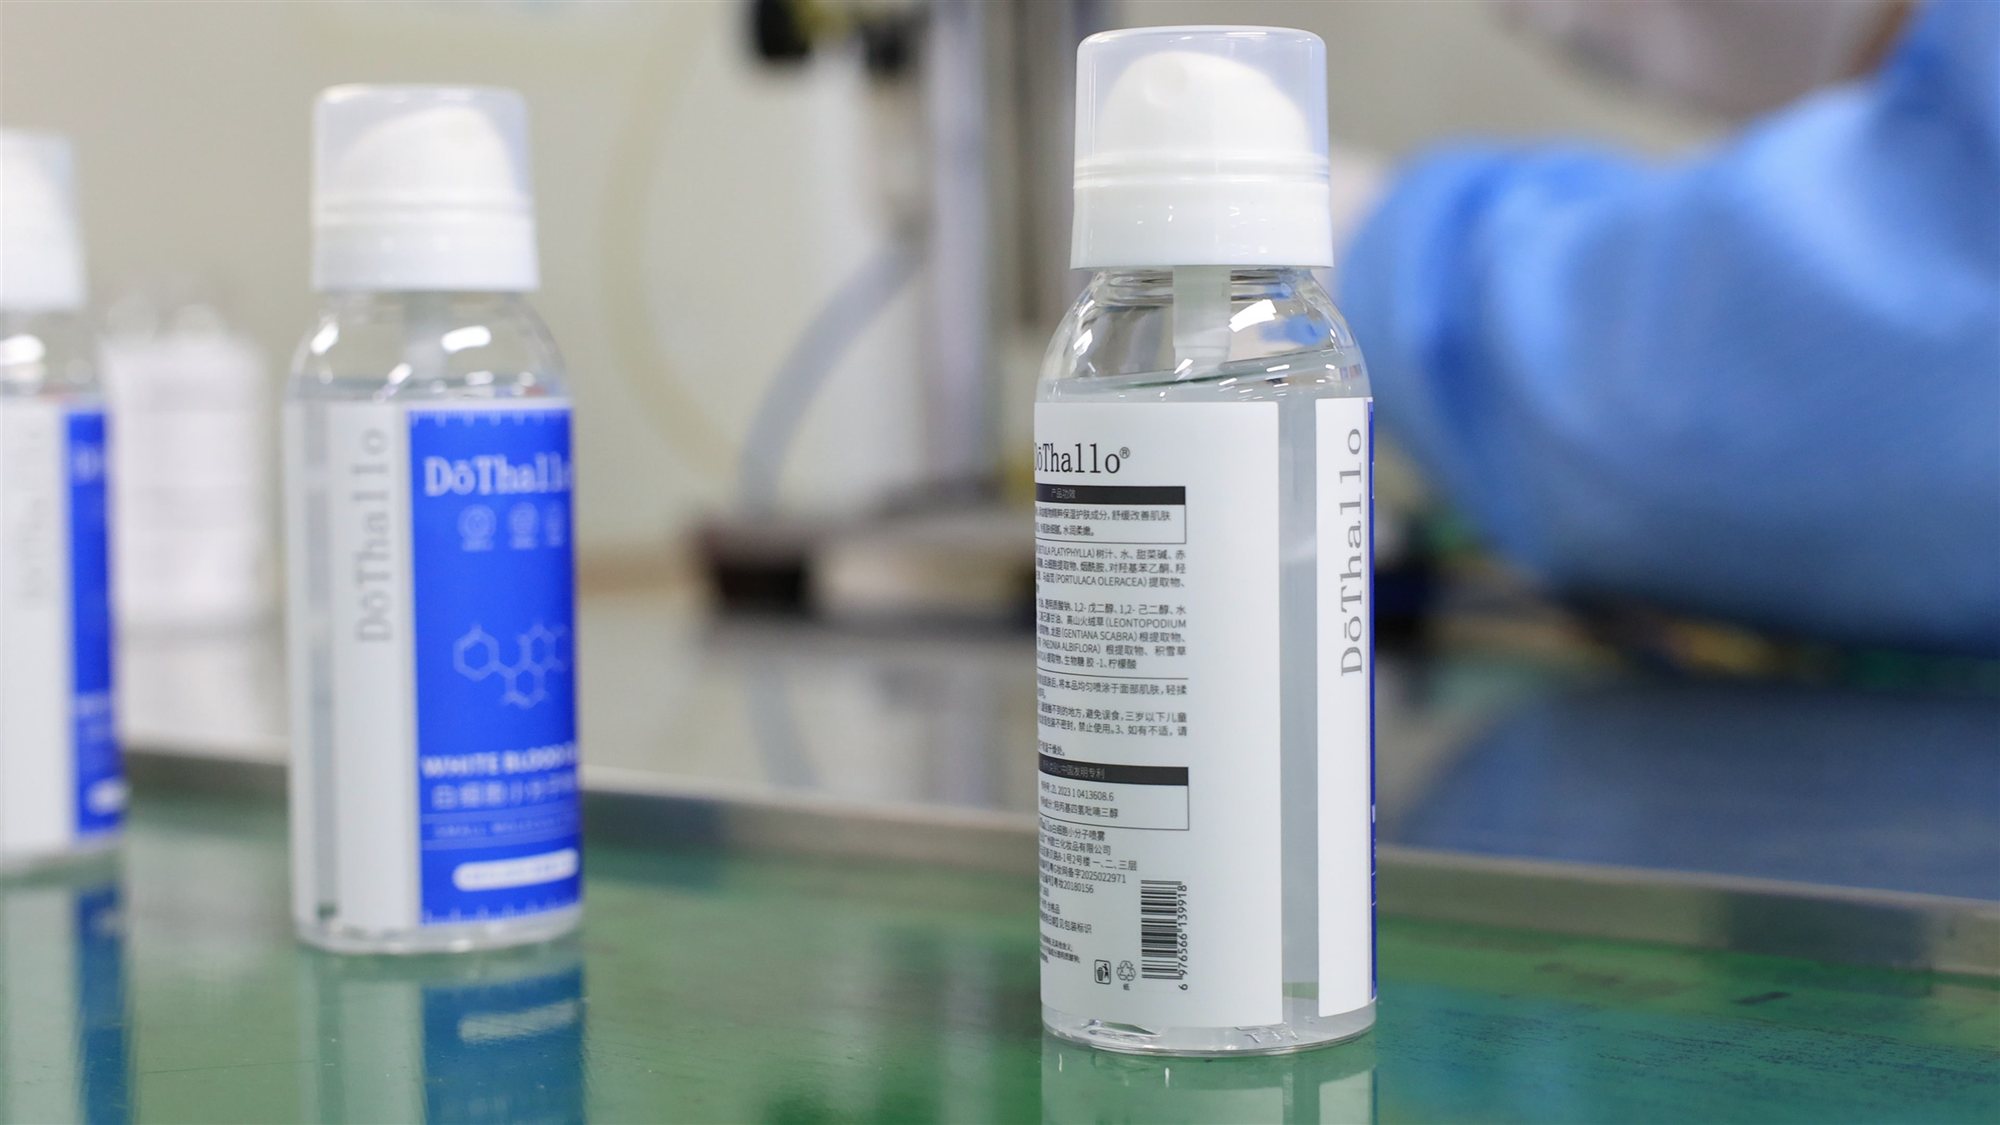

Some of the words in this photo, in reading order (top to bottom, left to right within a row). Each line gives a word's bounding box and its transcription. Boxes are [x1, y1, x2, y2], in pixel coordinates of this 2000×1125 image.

[1339, 428, 1363, 677] DōThallo
[1177, 885, 1188, 927] 139918
[1177, 933, 1188, 975] 976566
